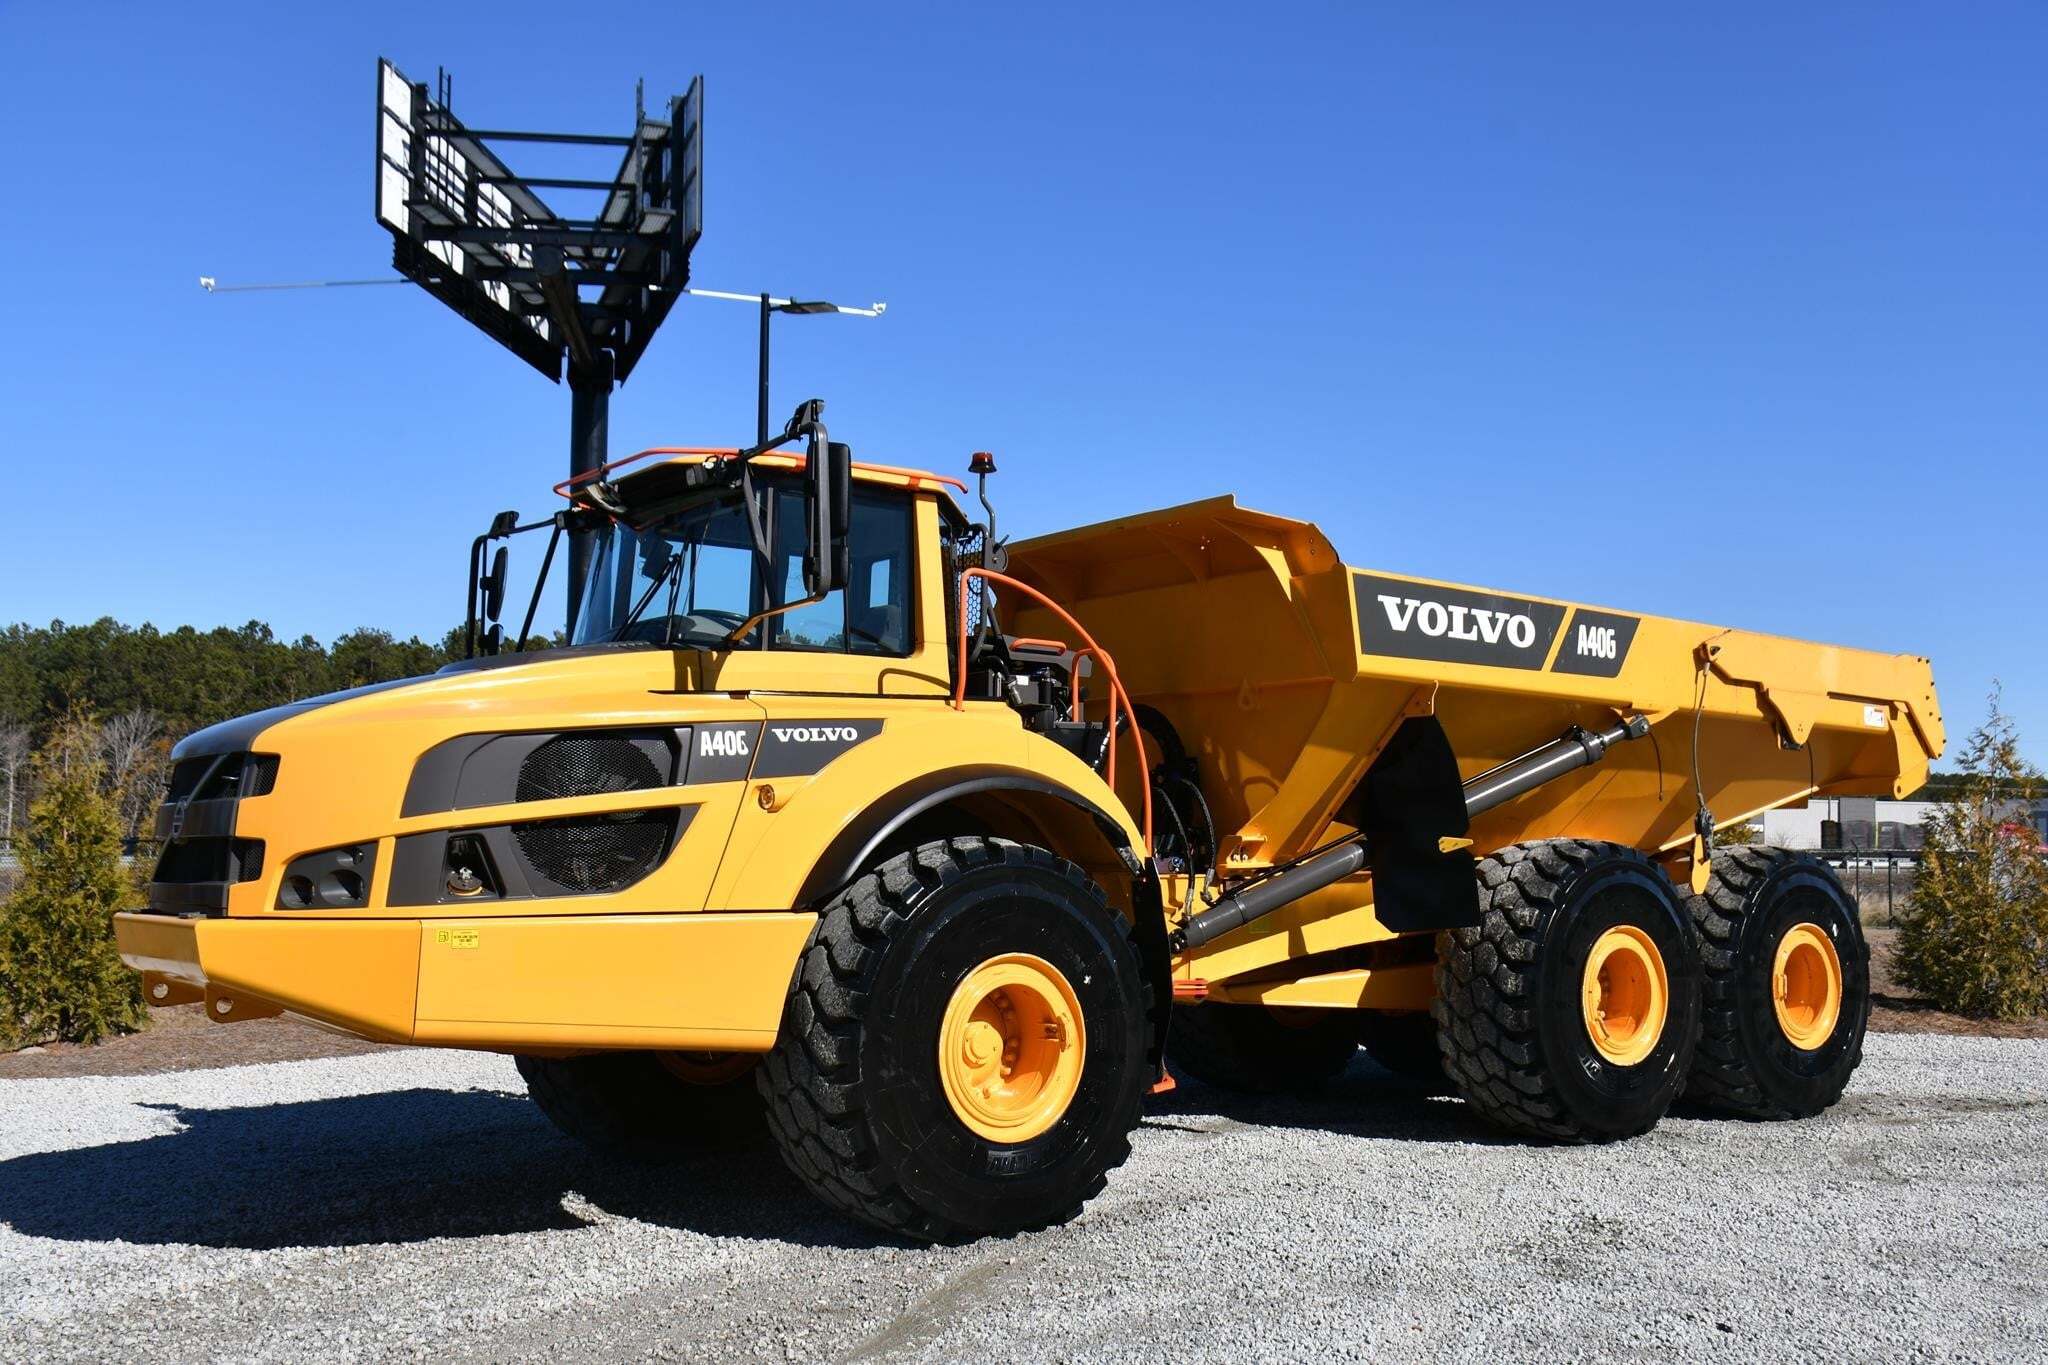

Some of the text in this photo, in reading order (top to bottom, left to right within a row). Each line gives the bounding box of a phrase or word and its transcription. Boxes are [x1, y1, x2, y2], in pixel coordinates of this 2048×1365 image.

[1377, 594, 1617, 660] VOLVO A40G
[771, 726, 858, 743] VOLVO
